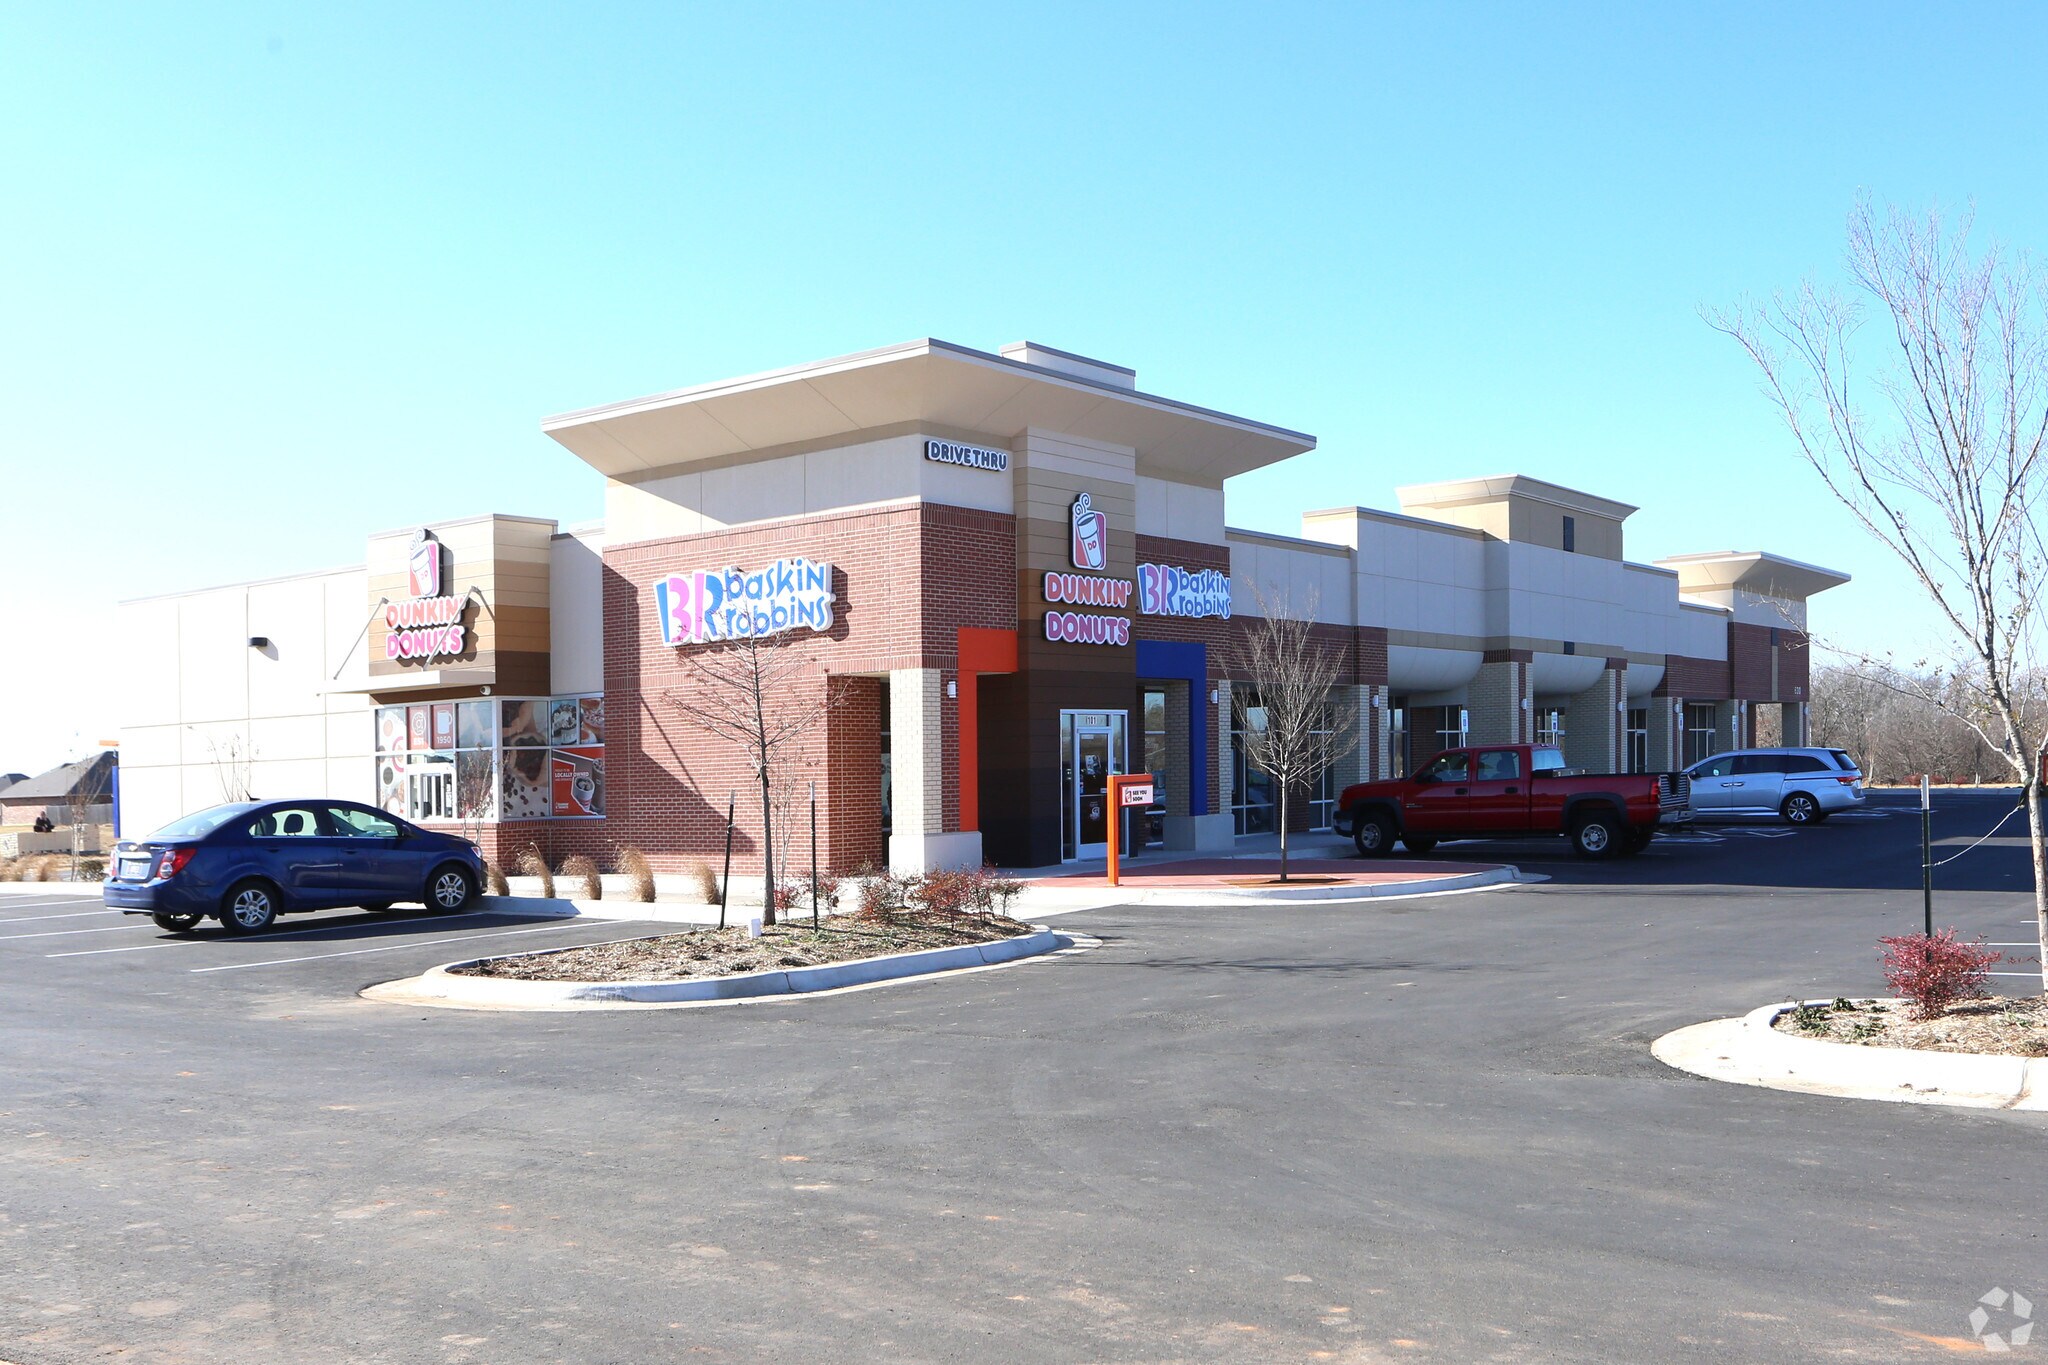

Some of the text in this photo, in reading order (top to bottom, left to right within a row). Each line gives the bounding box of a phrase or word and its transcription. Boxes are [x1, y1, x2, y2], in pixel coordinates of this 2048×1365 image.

[1046, 572, 1132, 608] DUNKIN'
[1138, 564, 1178, 614] BR
[655, 572, 724, 643] BR
[386, 626, 462, 658] DONUTS
[1047, 612, 1130, 645] DONUTS
[436, 735, 452, 744] 1950
